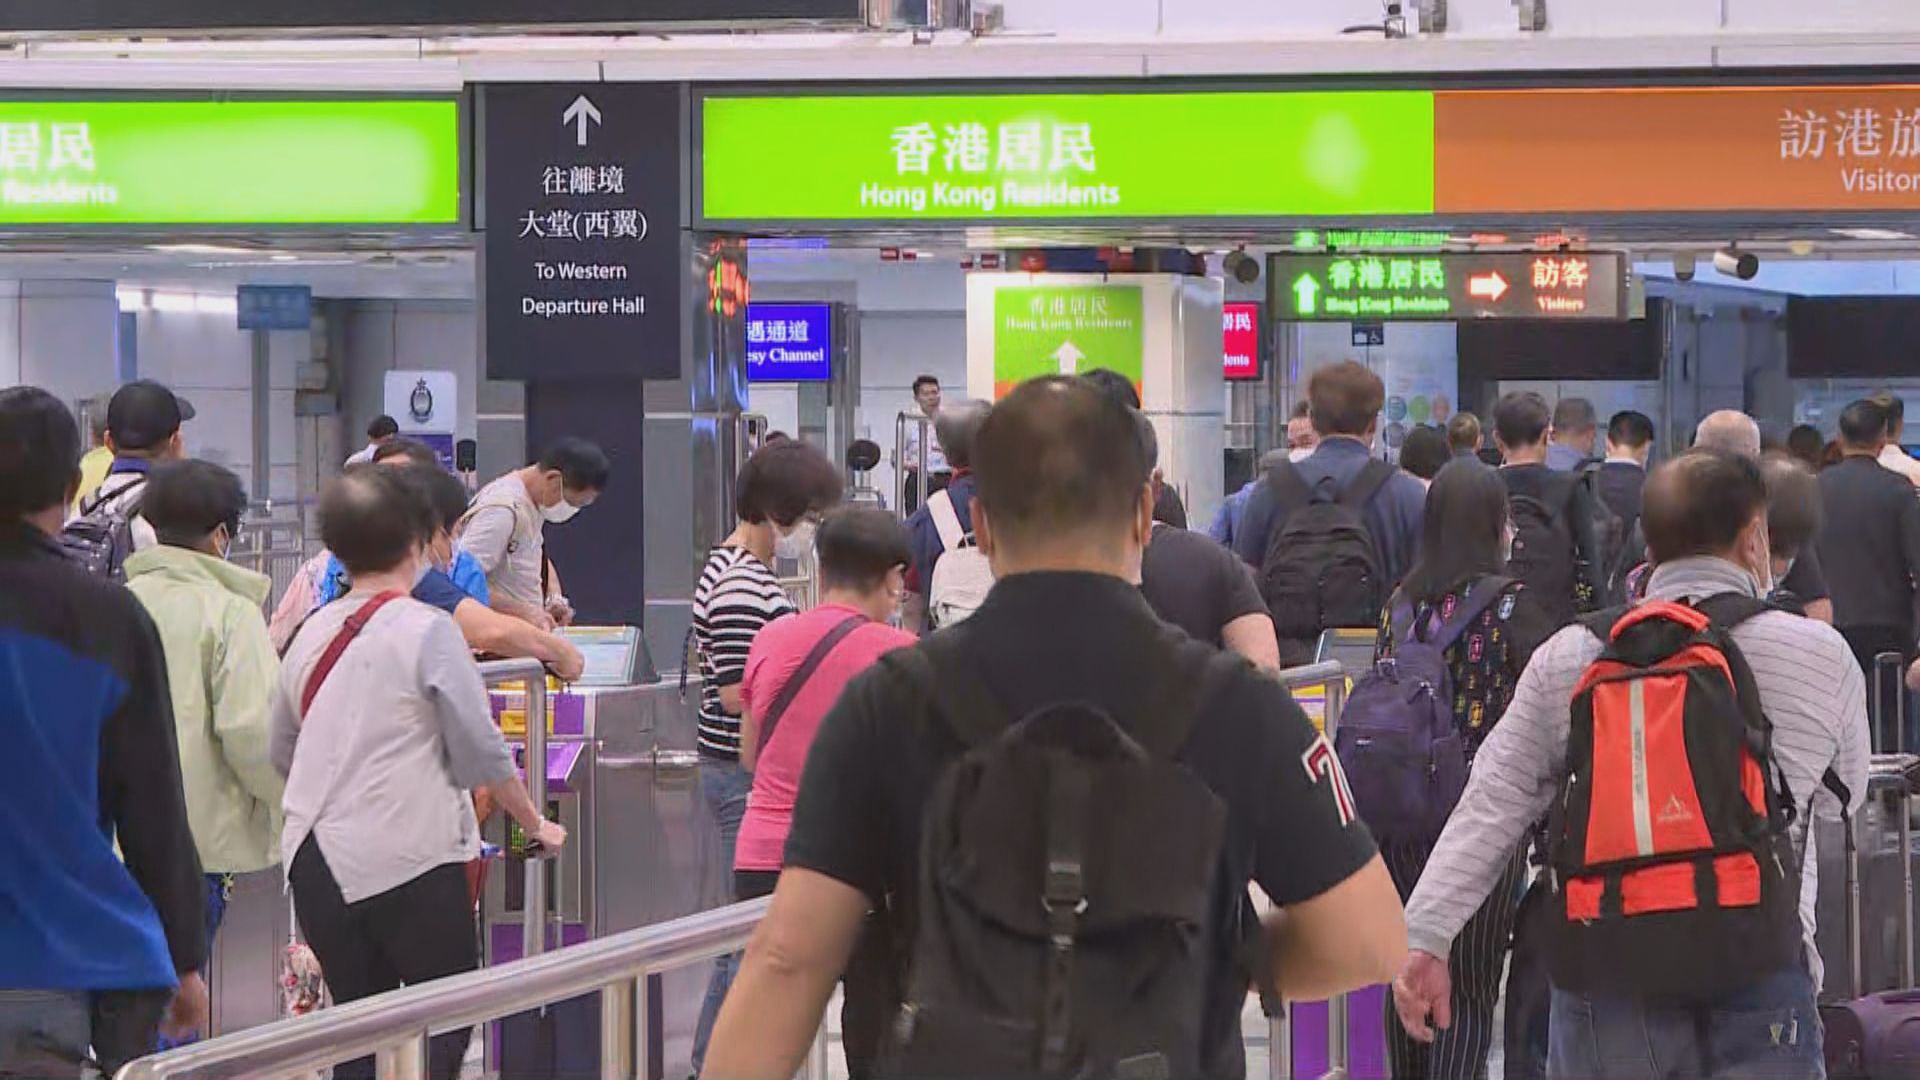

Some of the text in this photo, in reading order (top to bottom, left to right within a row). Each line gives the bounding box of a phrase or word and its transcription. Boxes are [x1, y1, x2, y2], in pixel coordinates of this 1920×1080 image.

[0, 122, 95, 172] 居民
[890, 121, 1096, 174] 香港居民
[543, 165, 624, 196] 往離境
[860, 179, 1120, 211] Hong Kong Residents
[519, 209, 648, 242] 大堂(西翼)
[534, 262, 627, 279] To Western
[1328, 256, 1444, 290] 香港居民
[1533, 258, 1588, 289] 訪客
[522, 296, 645, 318] Departure Hall
[1538, 296, 1584, 311] Visitors
[769, 348, 824, 362] Channel
